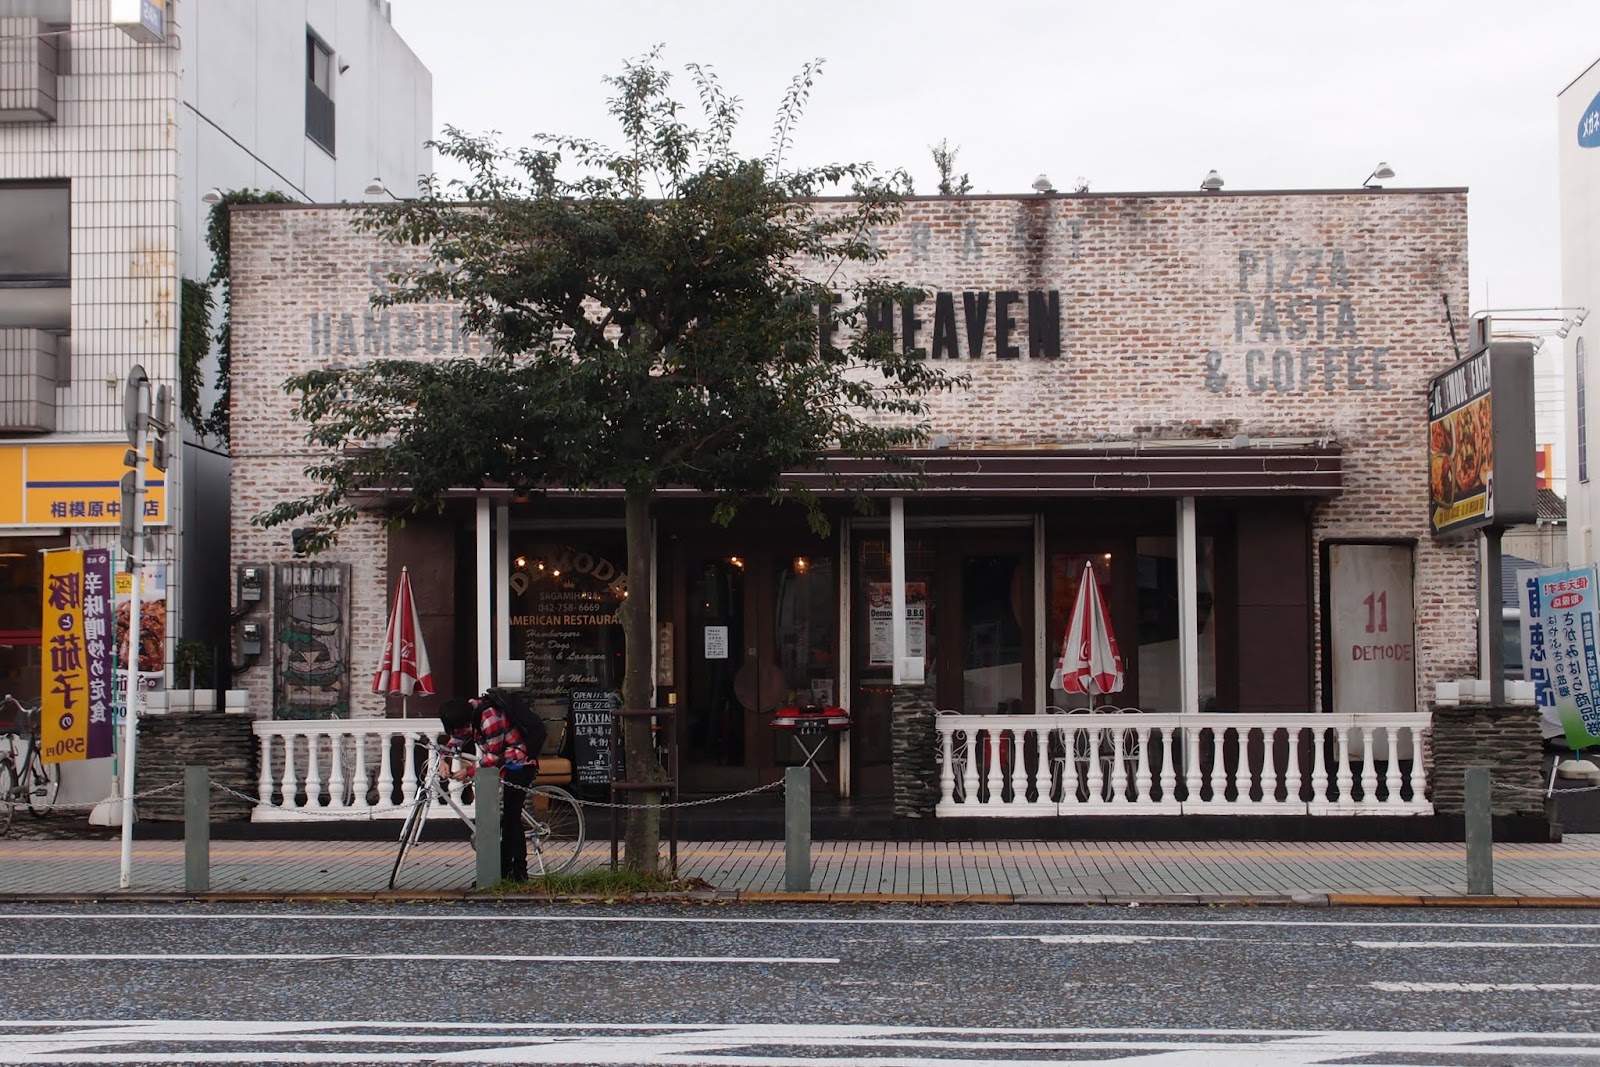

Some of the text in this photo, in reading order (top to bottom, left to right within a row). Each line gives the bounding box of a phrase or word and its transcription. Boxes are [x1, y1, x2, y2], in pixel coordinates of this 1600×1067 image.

[1239, 249, 1350, 293] PIZZA
[866, 290, 1061, 360] HEAVEN
[1234, 298, 1358, 344] PASTA
[1205, 348, 1391, 393] & COFFEE
[51, 500, 160, 518] 相模原中店
[539, 591, 598, 601] SAGAMIHARA
[538, 603, 600, 612] 042-758-6669
[1363, 591, 1388, 633] 11
[526, 628, 581, 640] Hamburgers
[526, 640, 571, 651] Hot Dogs
[555, 651, 563, 660] &
[1352, 644, 1413, 661] DEMODE
[557, 674, 565, 683] &
[573, 691, 592, 699] OPEN
[572, 701, 592, 709] CLOSE
[575, 713, 611, 725] PARKIN
